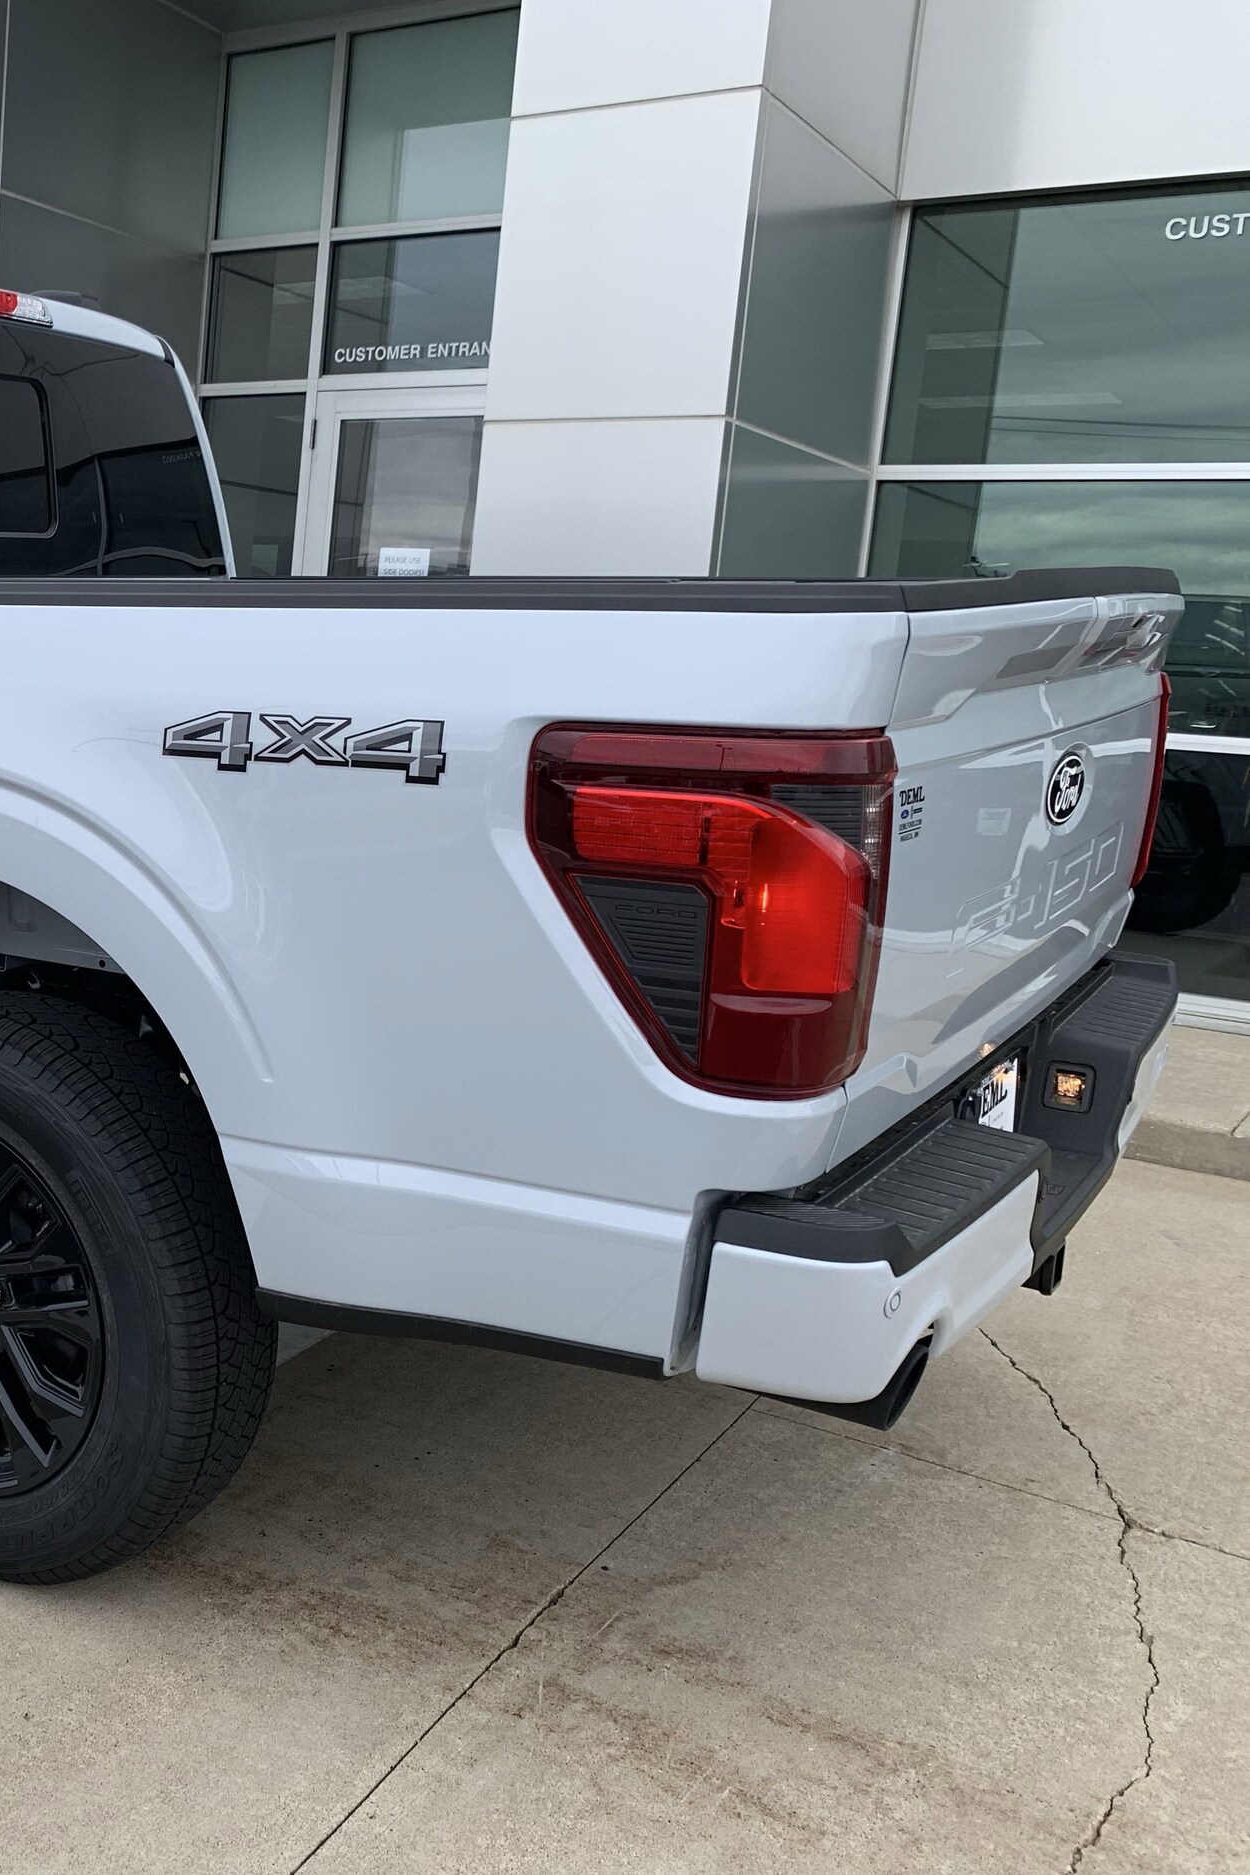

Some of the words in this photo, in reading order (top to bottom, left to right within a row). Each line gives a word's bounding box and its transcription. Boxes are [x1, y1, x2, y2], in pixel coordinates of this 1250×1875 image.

[1165, 213, 1250, 240] CUST
[334, 344, 420, 362] CUSTOMER
[427, 341, 490, 357] ENTRAN
[384, 556, 407, 564] PLEASE
[899, 786, 925, 807] DEML
[1053, 765, 1082, 813] Ford
[615, 904, 698, 919] FORD
